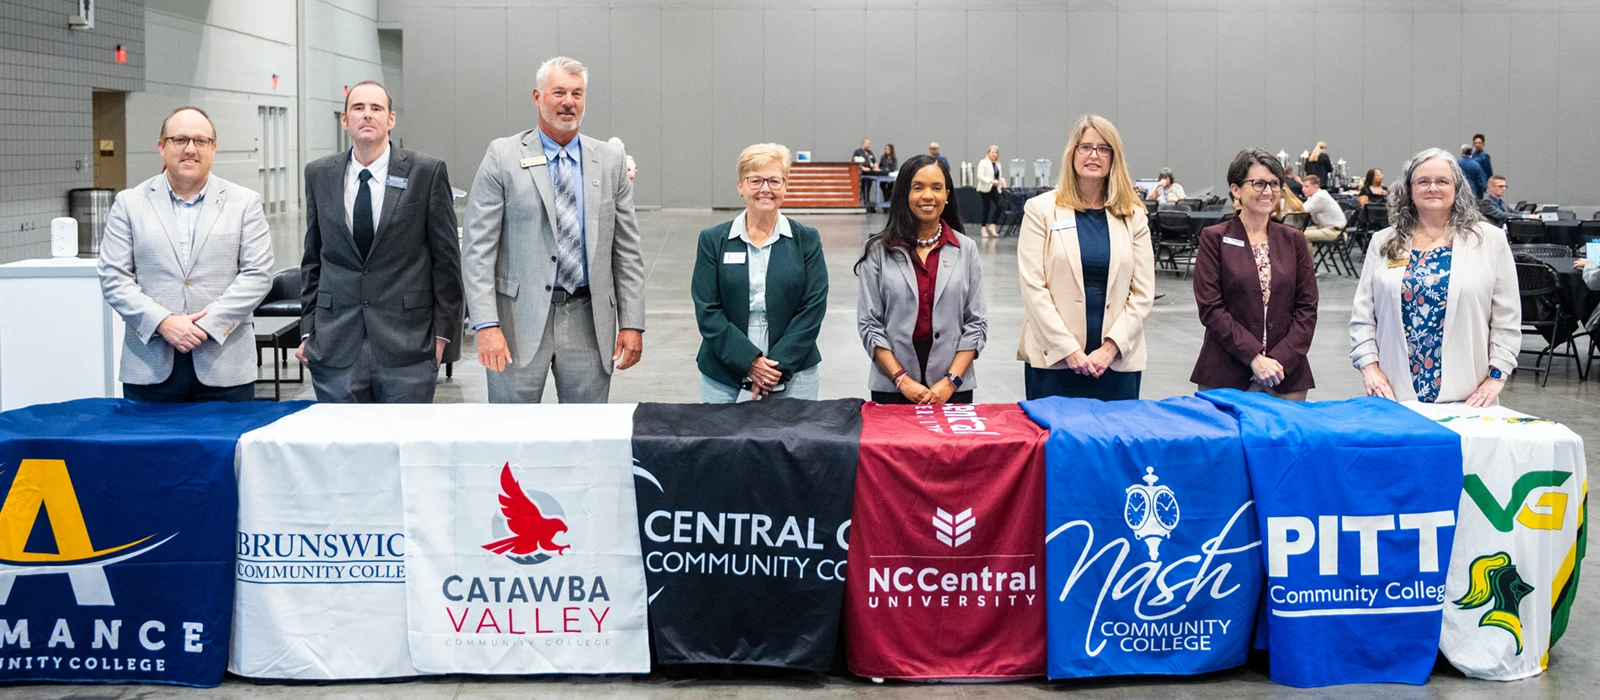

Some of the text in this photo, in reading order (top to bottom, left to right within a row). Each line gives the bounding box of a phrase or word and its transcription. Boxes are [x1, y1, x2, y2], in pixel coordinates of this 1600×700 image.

[644, 509, 823, 550] CENTRAL
[237, 531, 405, 558] BRUNSWIC
[1267, 510, 1456, 577] PITT
[237, 563, 406, 579] COMMUNITY COLLE
[646, 551, 811, 579] COMMUNITY
[442, 574, 611, 603] CATAWBA
[1270, 584, 1379, 606] Community
[868, 594, 1036, 608] UNIVERSITY
[445, 607, 611, 634] VALLEY
[1100, 619, 1232, 638] COMMUNITY
[0, 618, 204, 653] MANCE
[445, 638, 612, 647] COMMUNITY COLLEGE
[1120, 634, 1212, 652] COLLEGE
[0, 656, 166, 672] NITY COLLEGE
